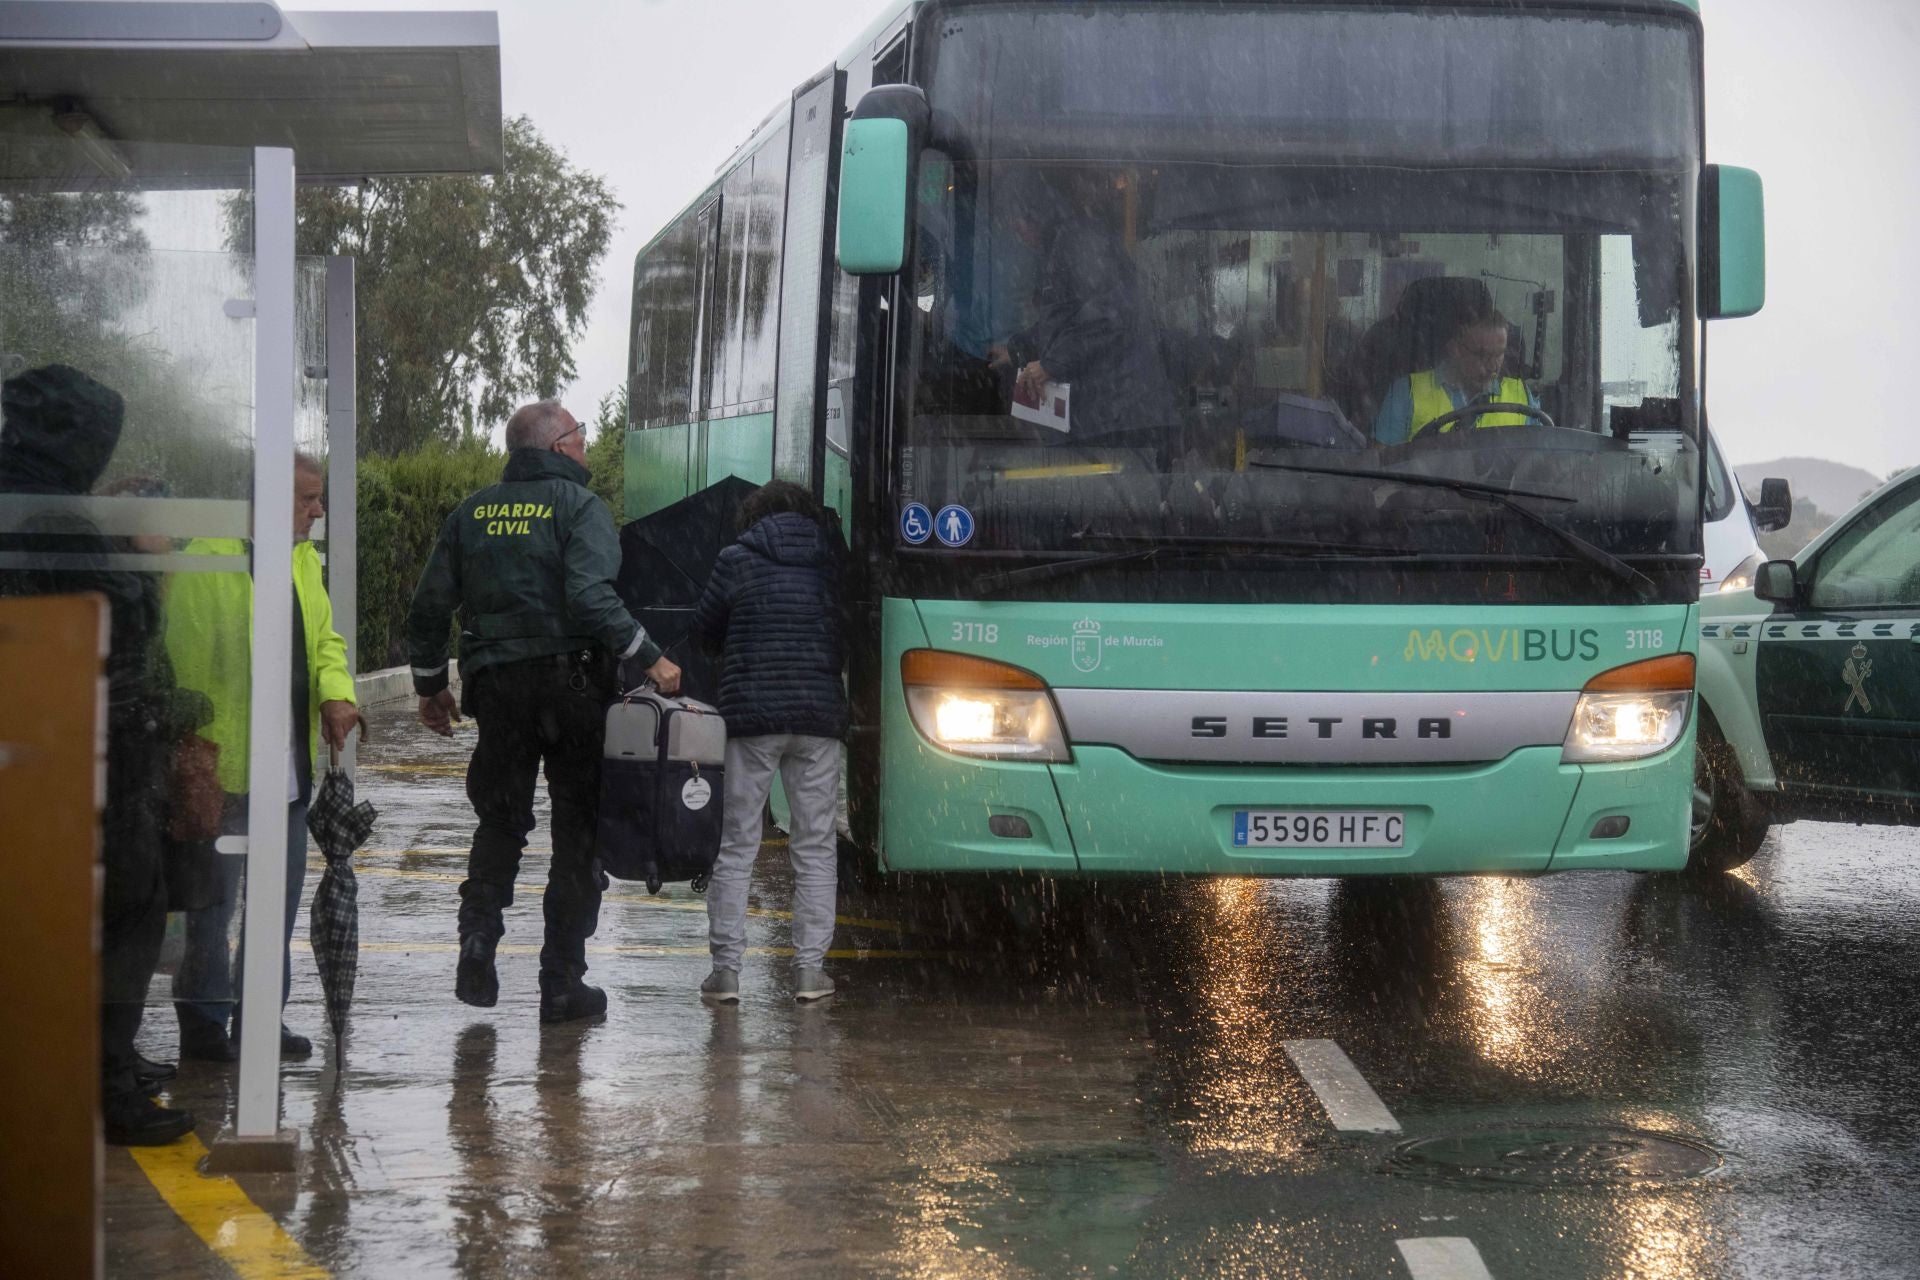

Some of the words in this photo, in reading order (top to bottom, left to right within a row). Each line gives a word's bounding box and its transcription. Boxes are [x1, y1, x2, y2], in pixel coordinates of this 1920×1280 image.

[473, 503, 553, 519] GUARDIA
[486, 520, 531, 535] CIVIL
[951, 621, 998, 643] 3118
[1027, 634, 1068, 648] Región
[1104, 635, 1120, 646] de
[1123, 635, 1163, 647] Murcia
[1625, 629, 1664, 649] 3118
[1404, 628, 1600, 663] MOVIBUS
[1191, 716, 1452, 739] SETRA
[1237, 832, 1245, 841] E
[1253, 815, 1329, 843] 5596
[1339, 815, 1402, 843] HFC
